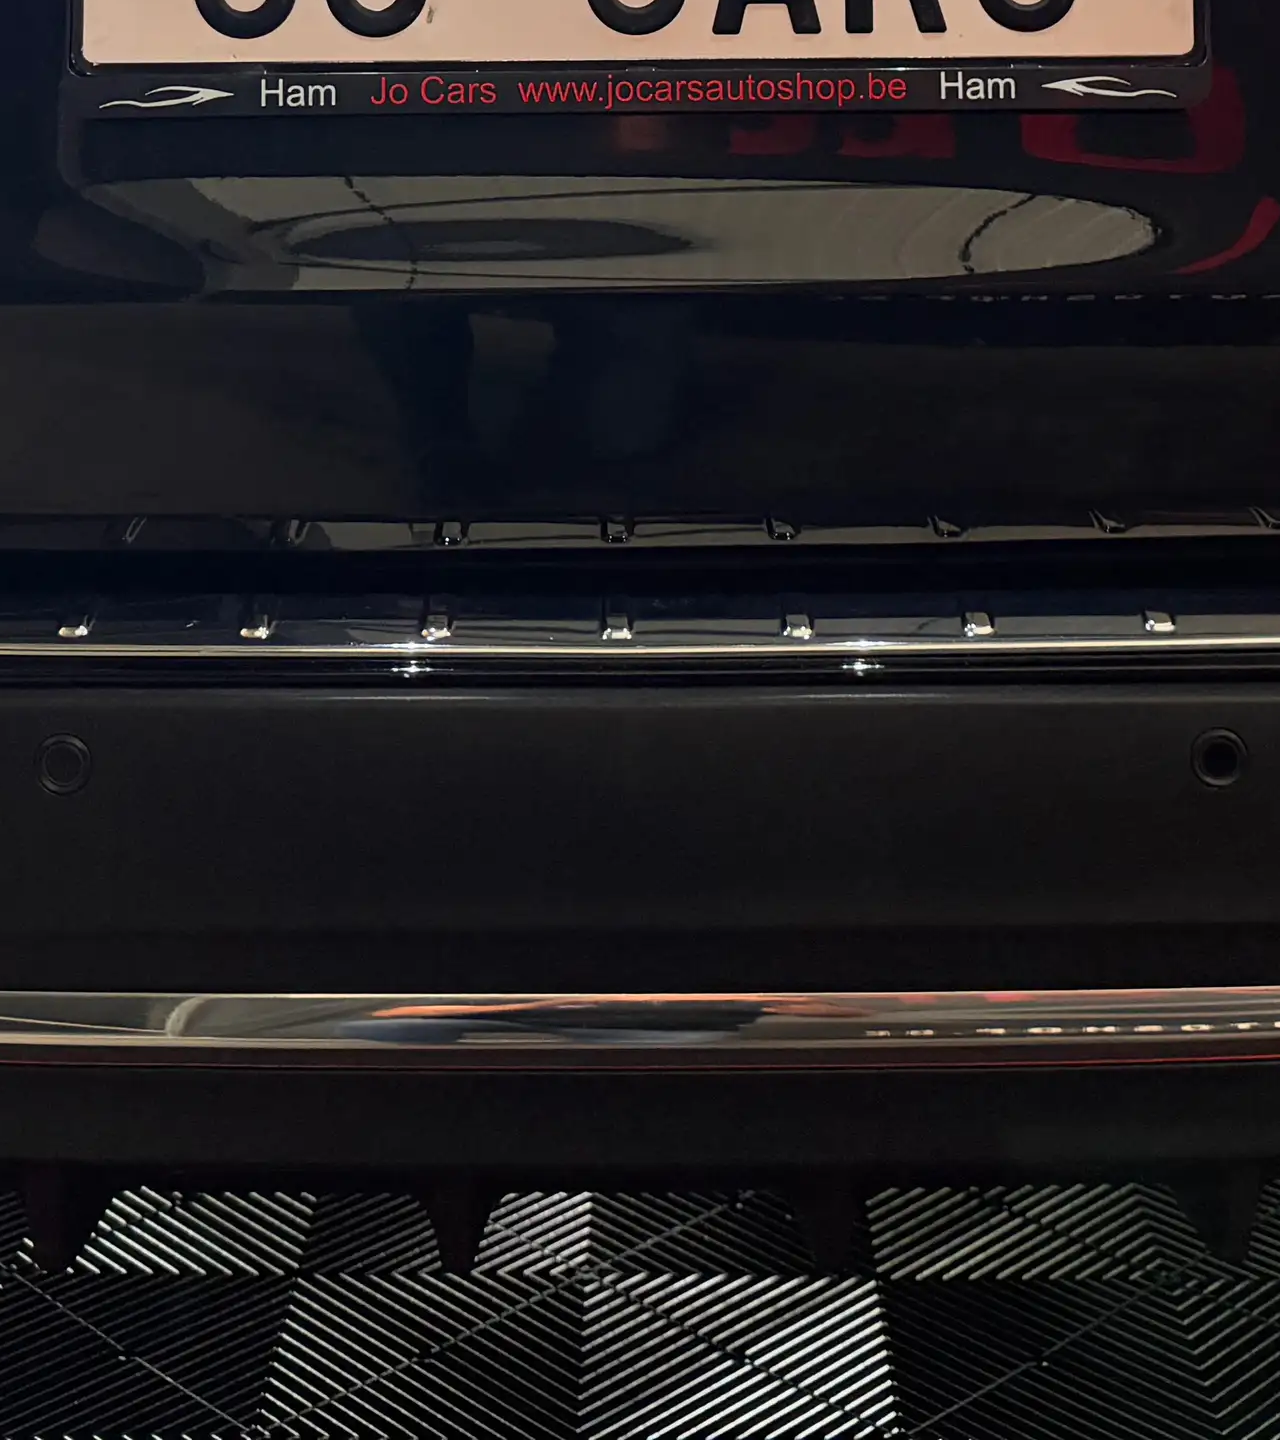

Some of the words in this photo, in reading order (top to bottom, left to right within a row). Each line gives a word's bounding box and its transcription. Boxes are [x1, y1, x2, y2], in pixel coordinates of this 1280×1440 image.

[260, 78, 337, 107] Ham
[370, 76, 410, 105] Jo
[420, 76, 497, 104] Cars
[518, 72, 908, 110] www.jocarsautoshop.be
[939, 71, 1017, 100] Ham
